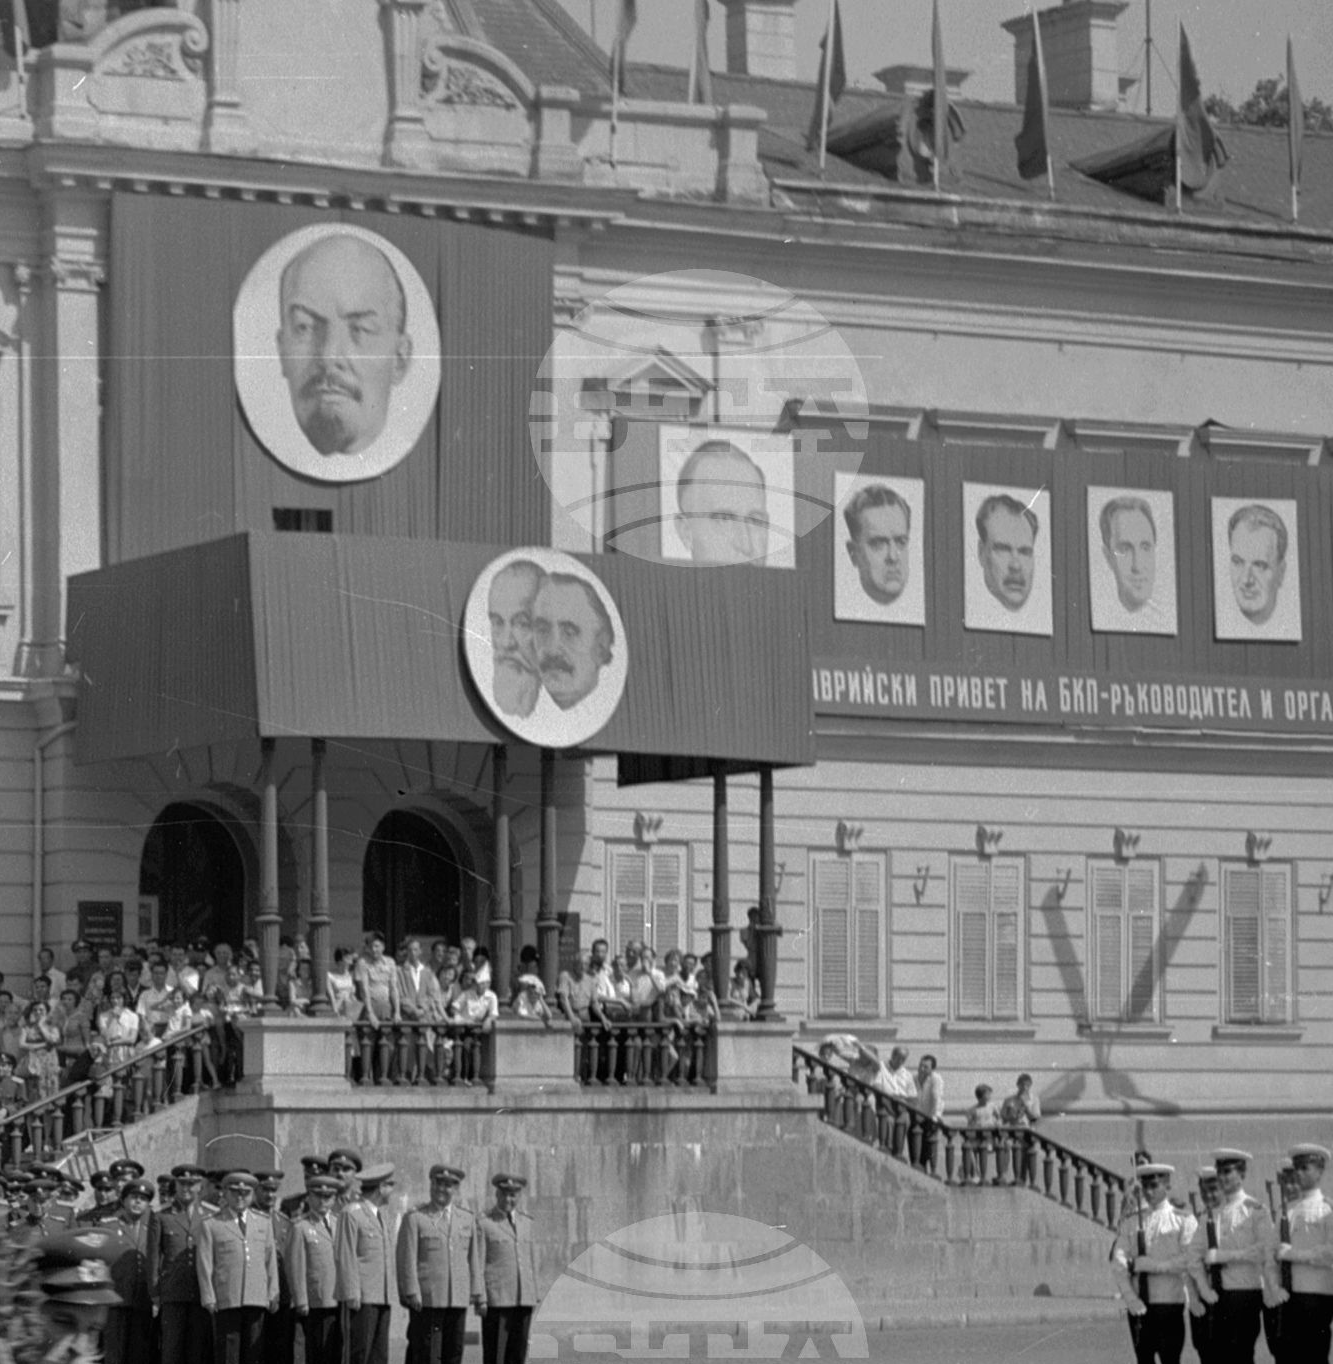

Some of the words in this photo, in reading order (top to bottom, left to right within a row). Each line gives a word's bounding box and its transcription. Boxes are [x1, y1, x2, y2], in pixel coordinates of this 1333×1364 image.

[929, 674, 1008, 711] ПРИВЕТ
[1021, 678, 1048, 712] НА
[1059, 676, 1252, 721] БКП-РЪКОВОДИТЕЛ
[1261, 688, 1273, 720] И
[1284, 689, 1333, 722] ОРГА
